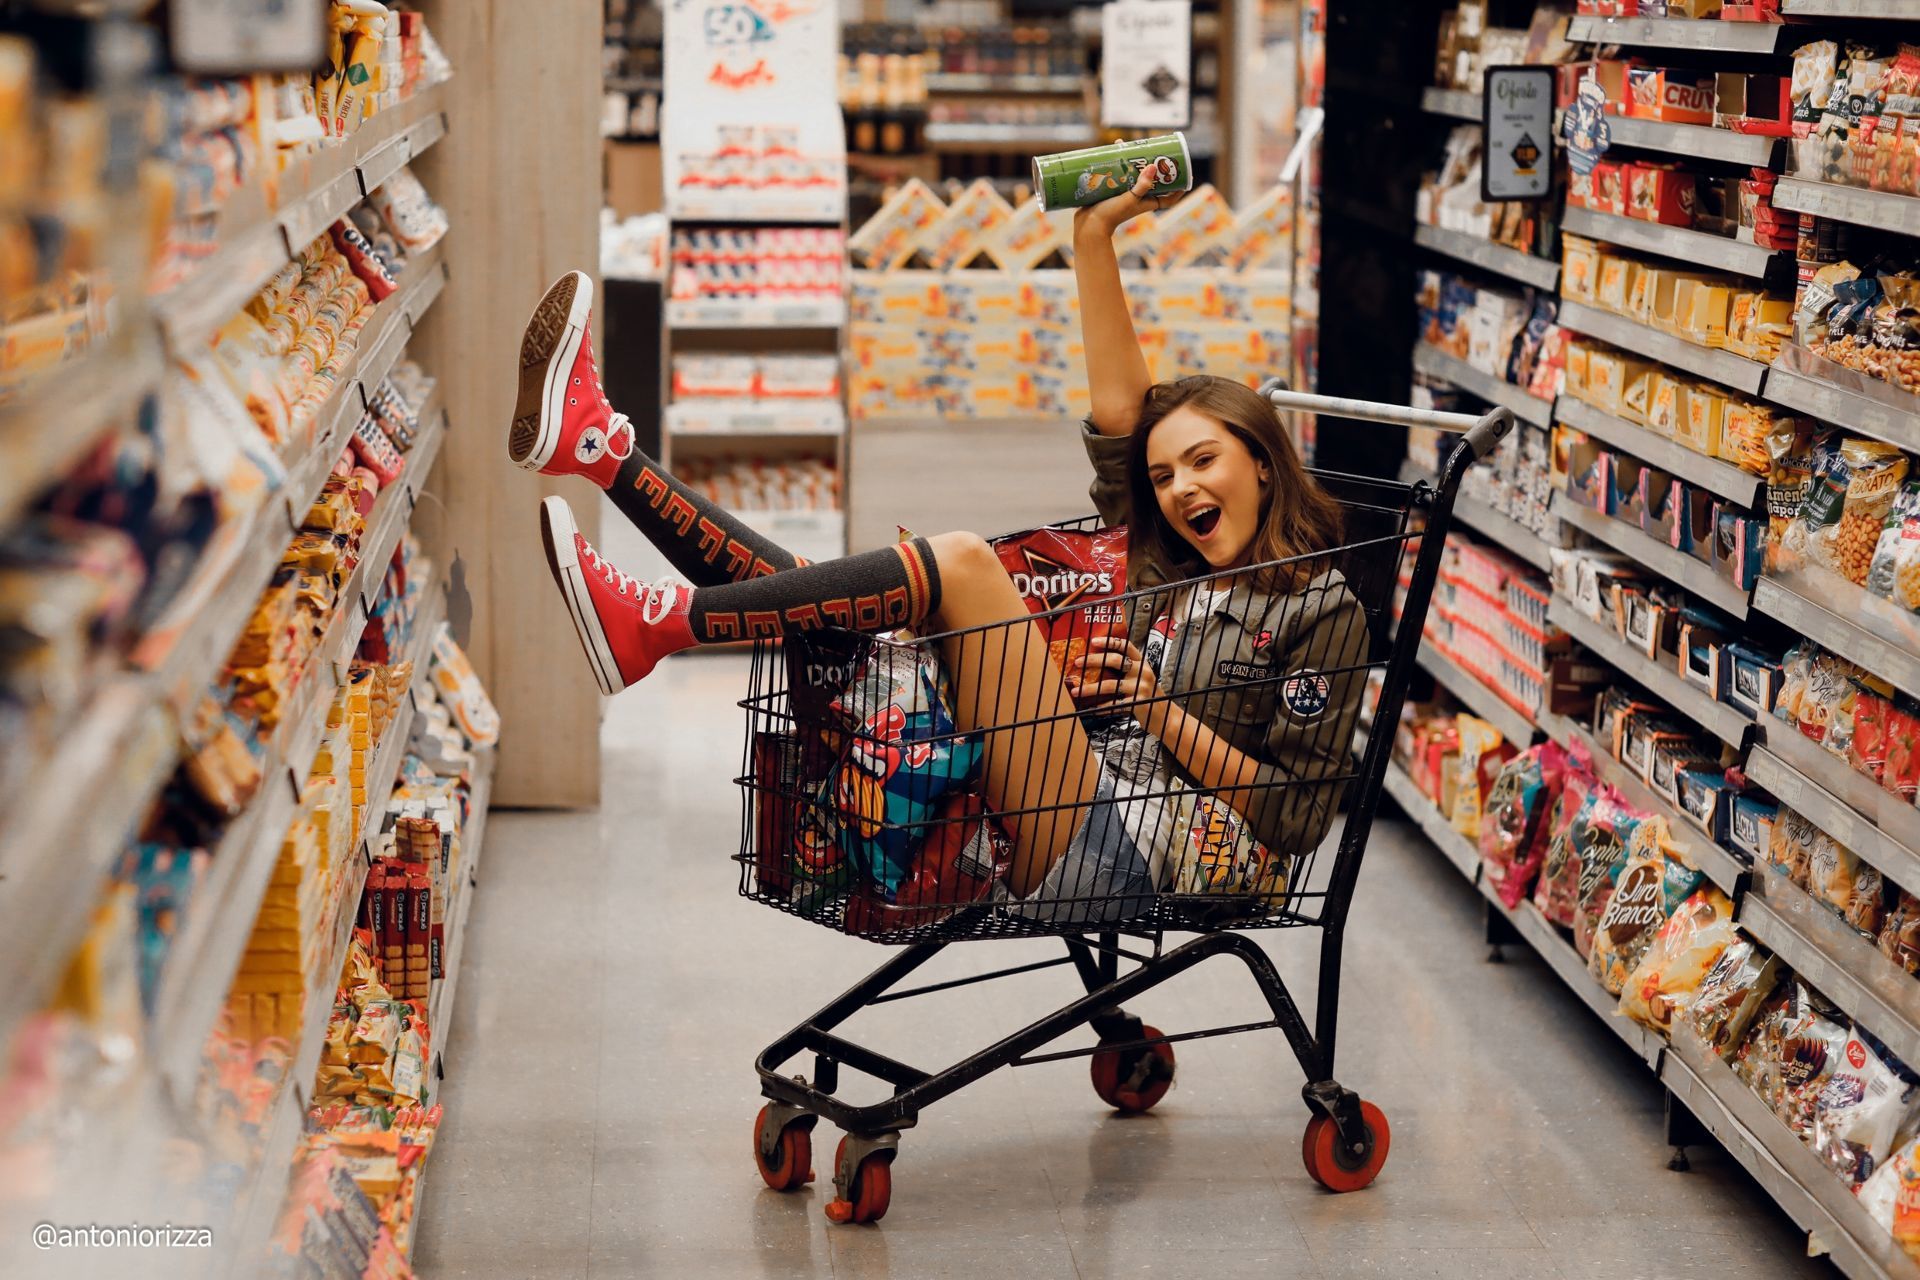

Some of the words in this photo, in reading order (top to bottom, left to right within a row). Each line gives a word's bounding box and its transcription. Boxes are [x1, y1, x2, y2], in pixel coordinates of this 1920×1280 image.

[1013, 568, 1113, 598] Doritos
[704, 586, 909, 639] COFFEE
[1617, 868, 1658, 904] Ouro
[1602, 902, 1657, 931] Branco
